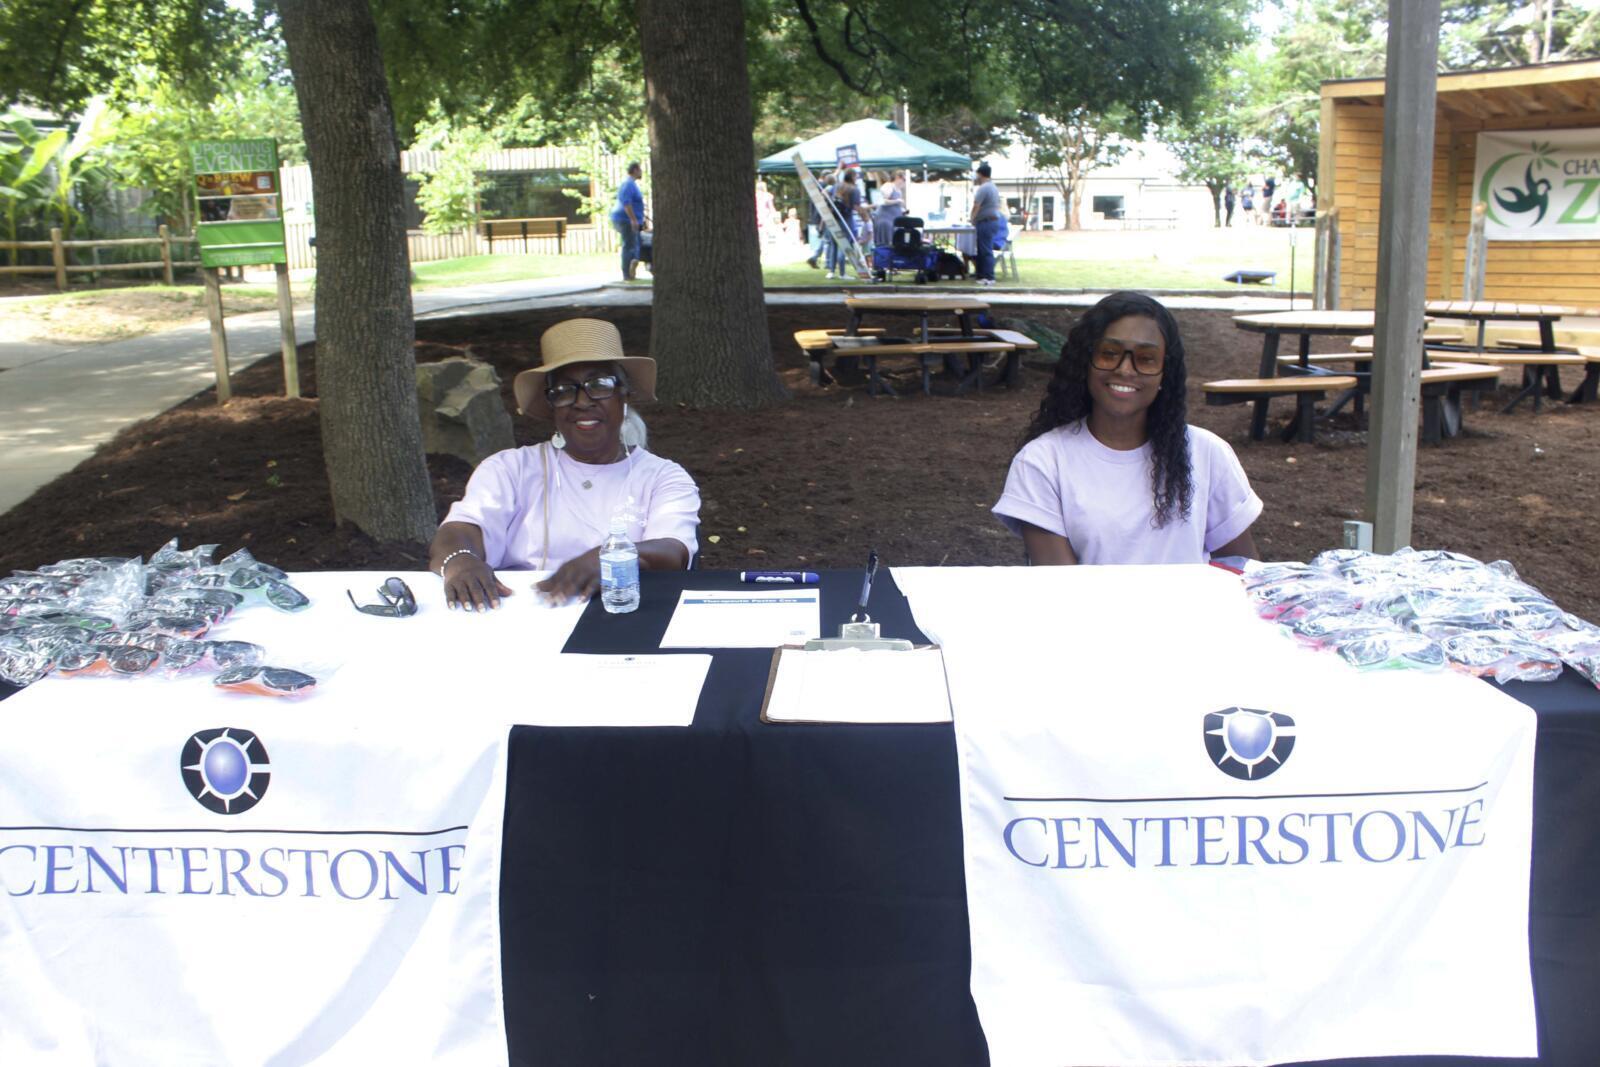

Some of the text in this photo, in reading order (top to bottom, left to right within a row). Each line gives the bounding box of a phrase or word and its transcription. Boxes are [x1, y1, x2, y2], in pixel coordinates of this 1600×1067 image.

[192, 141, 272, 155] UPCOMING
[193, 153, 273, 172] EVENTS!
[1555, 178, 1600, 225] Z
[1003, 798, 1486, 869] CENTERSTONE
[0, 845, 467, 900] CENTERSTONE
